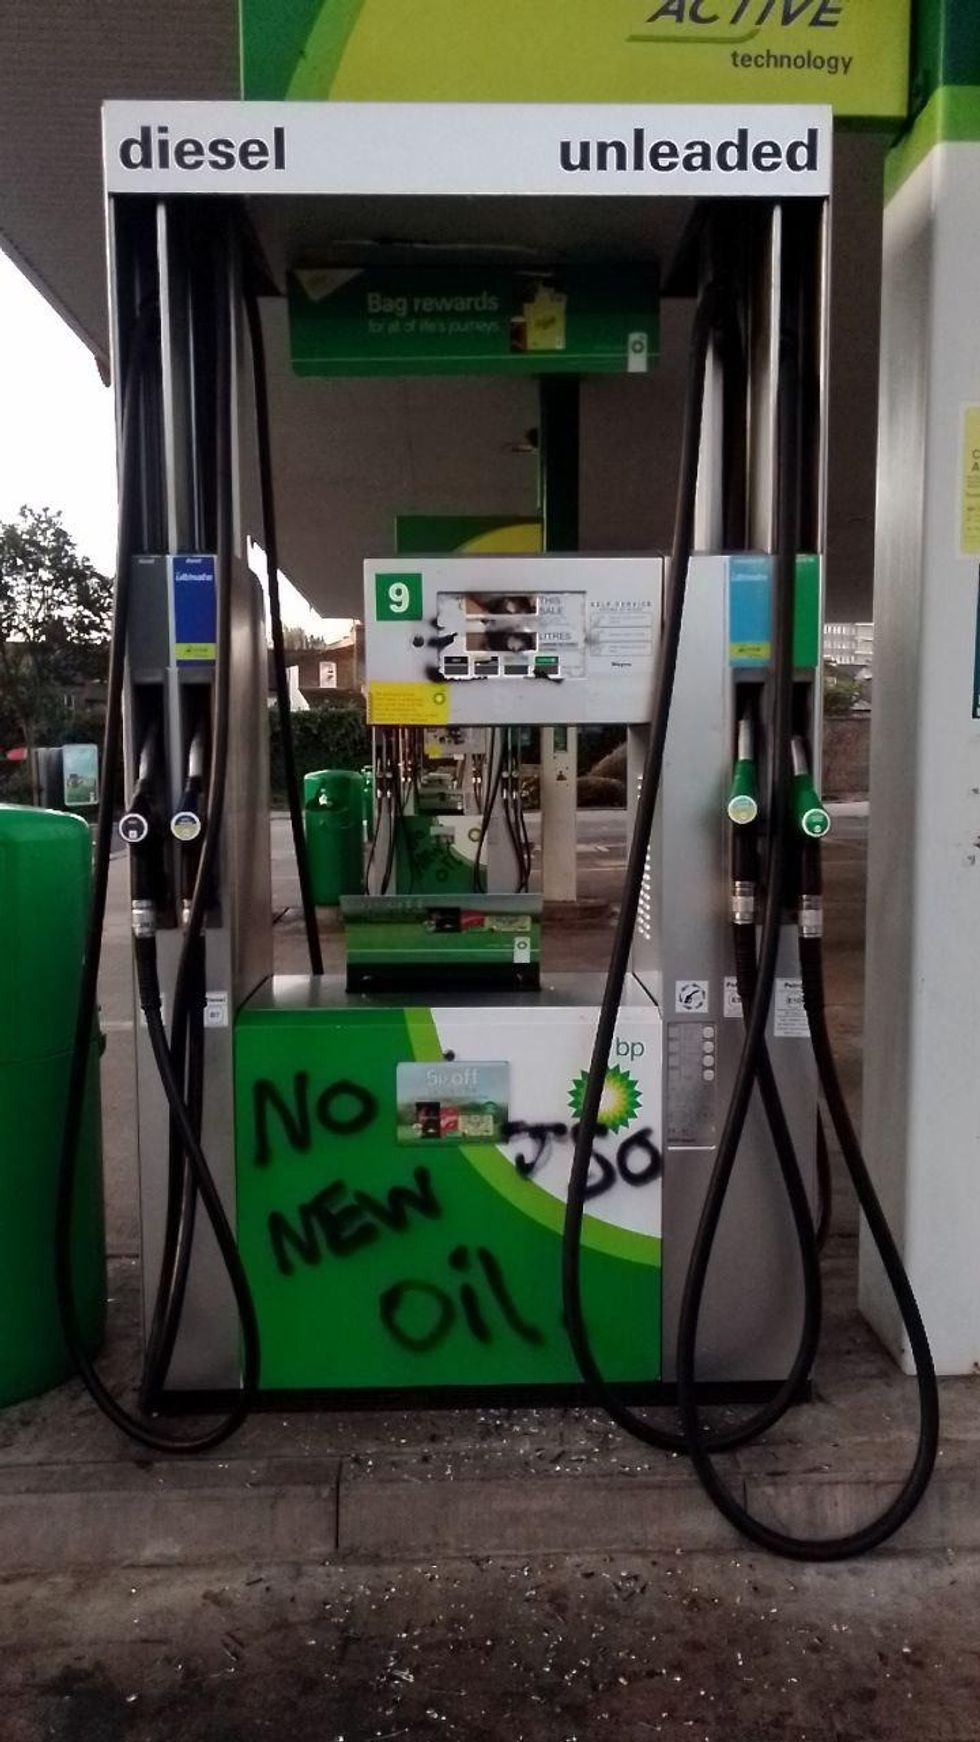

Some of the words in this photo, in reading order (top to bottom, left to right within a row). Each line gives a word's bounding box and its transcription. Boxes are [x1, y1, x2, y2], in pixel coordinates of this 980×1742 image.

[646, 0, 845, 27] ACTIVE
[731, 48, 853, 75] technology
[119, 125, 286, 171] diesel
[559, 127, 819, 172] unleaded
[367, 292, 408, 316] Bag
[413, 291, 499, 313] rewards
[368, 319, 384, 333] for
[386, 319, 402, 332] all
[404, 319, 417, 333] of
[447, 320, 500, 335] journeys
[387, 581, 410, 614] 9
[539, 596, 560, 605] THIS
[539, 606, 563, 615] SALE
[538, 632, 572, 641] LITRES
[615, 1036, 645, 1061] bp
[450, 1067, 479, 1086] off
[253, 1071, 378, 1168] NO
[267, 1165, 443, 1278] NEW
